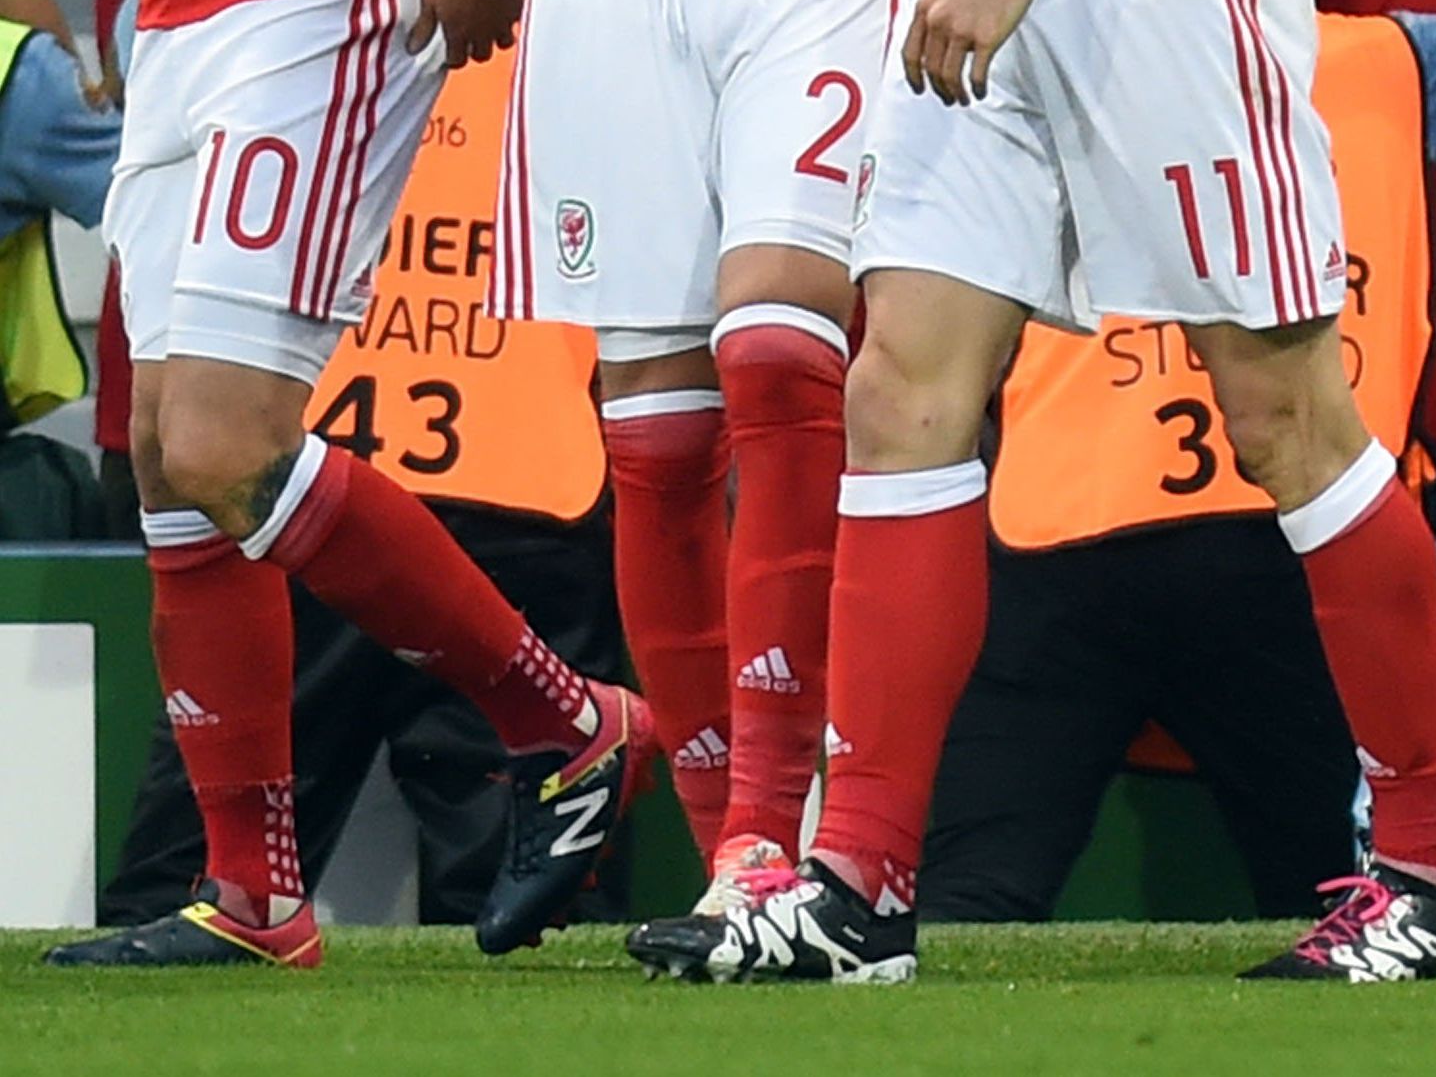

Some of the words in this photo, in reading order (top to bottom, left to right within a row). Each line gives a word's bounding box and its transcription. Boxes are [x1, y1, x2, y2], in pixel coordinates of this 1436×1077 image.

[795, 70, 863, 185] 2
[192, 130, 299, 251] 10
[1163, 158, 1252, 279] 11
[311, 374, 462, 476] 43
[1154, 397, 1217, 495] 3
